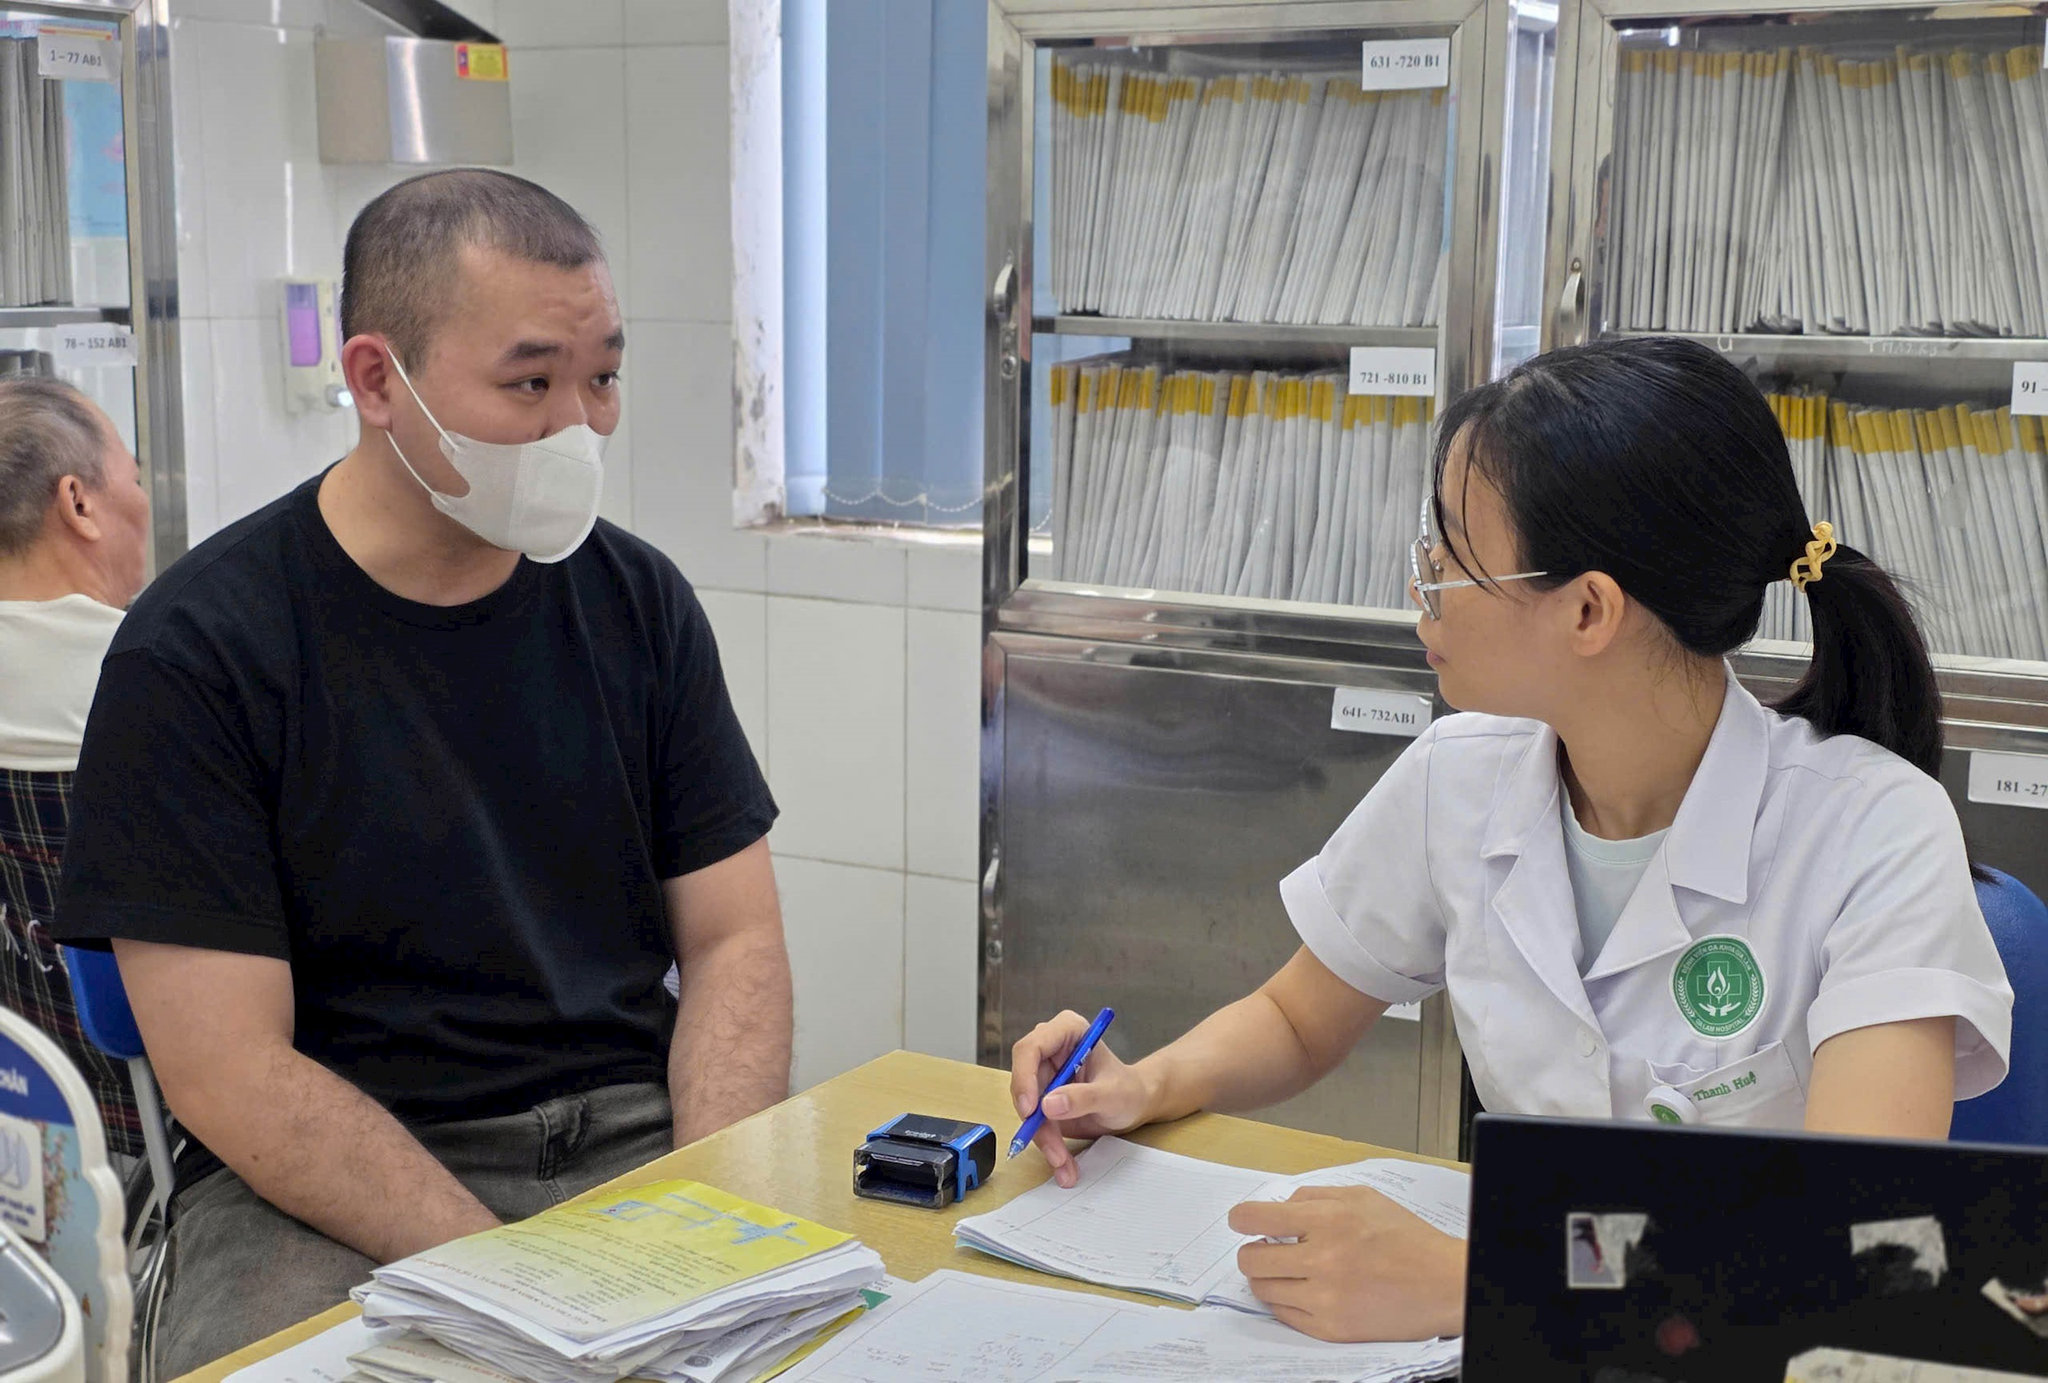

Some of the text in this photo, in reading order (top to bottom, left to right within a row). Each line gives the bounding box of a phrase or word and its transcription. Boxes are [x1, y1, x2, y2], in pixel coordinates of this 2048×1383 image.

[50, 50, 56, 61] 1
[67, 52, 80, 63] 77
[82, 55, 102, 66] AB1
[1370, 55, 1390, 68] 631
[1424, 53, 1439, 68] B1
[64, 338, 77, 349] 78
[87, 337, 105, 349] 152
[108, 337, 127, 349] AB1
[1360, 371, 1379, 384] 721
[1412, 373, 1427, 385] B1
[2021, 380, 2037, 394] 91
[1371, 708, 1416, 725] 732AB1
[1997, 779, 2019, 793] 181
[1693, 1083, 1731, 1101] Thanh
